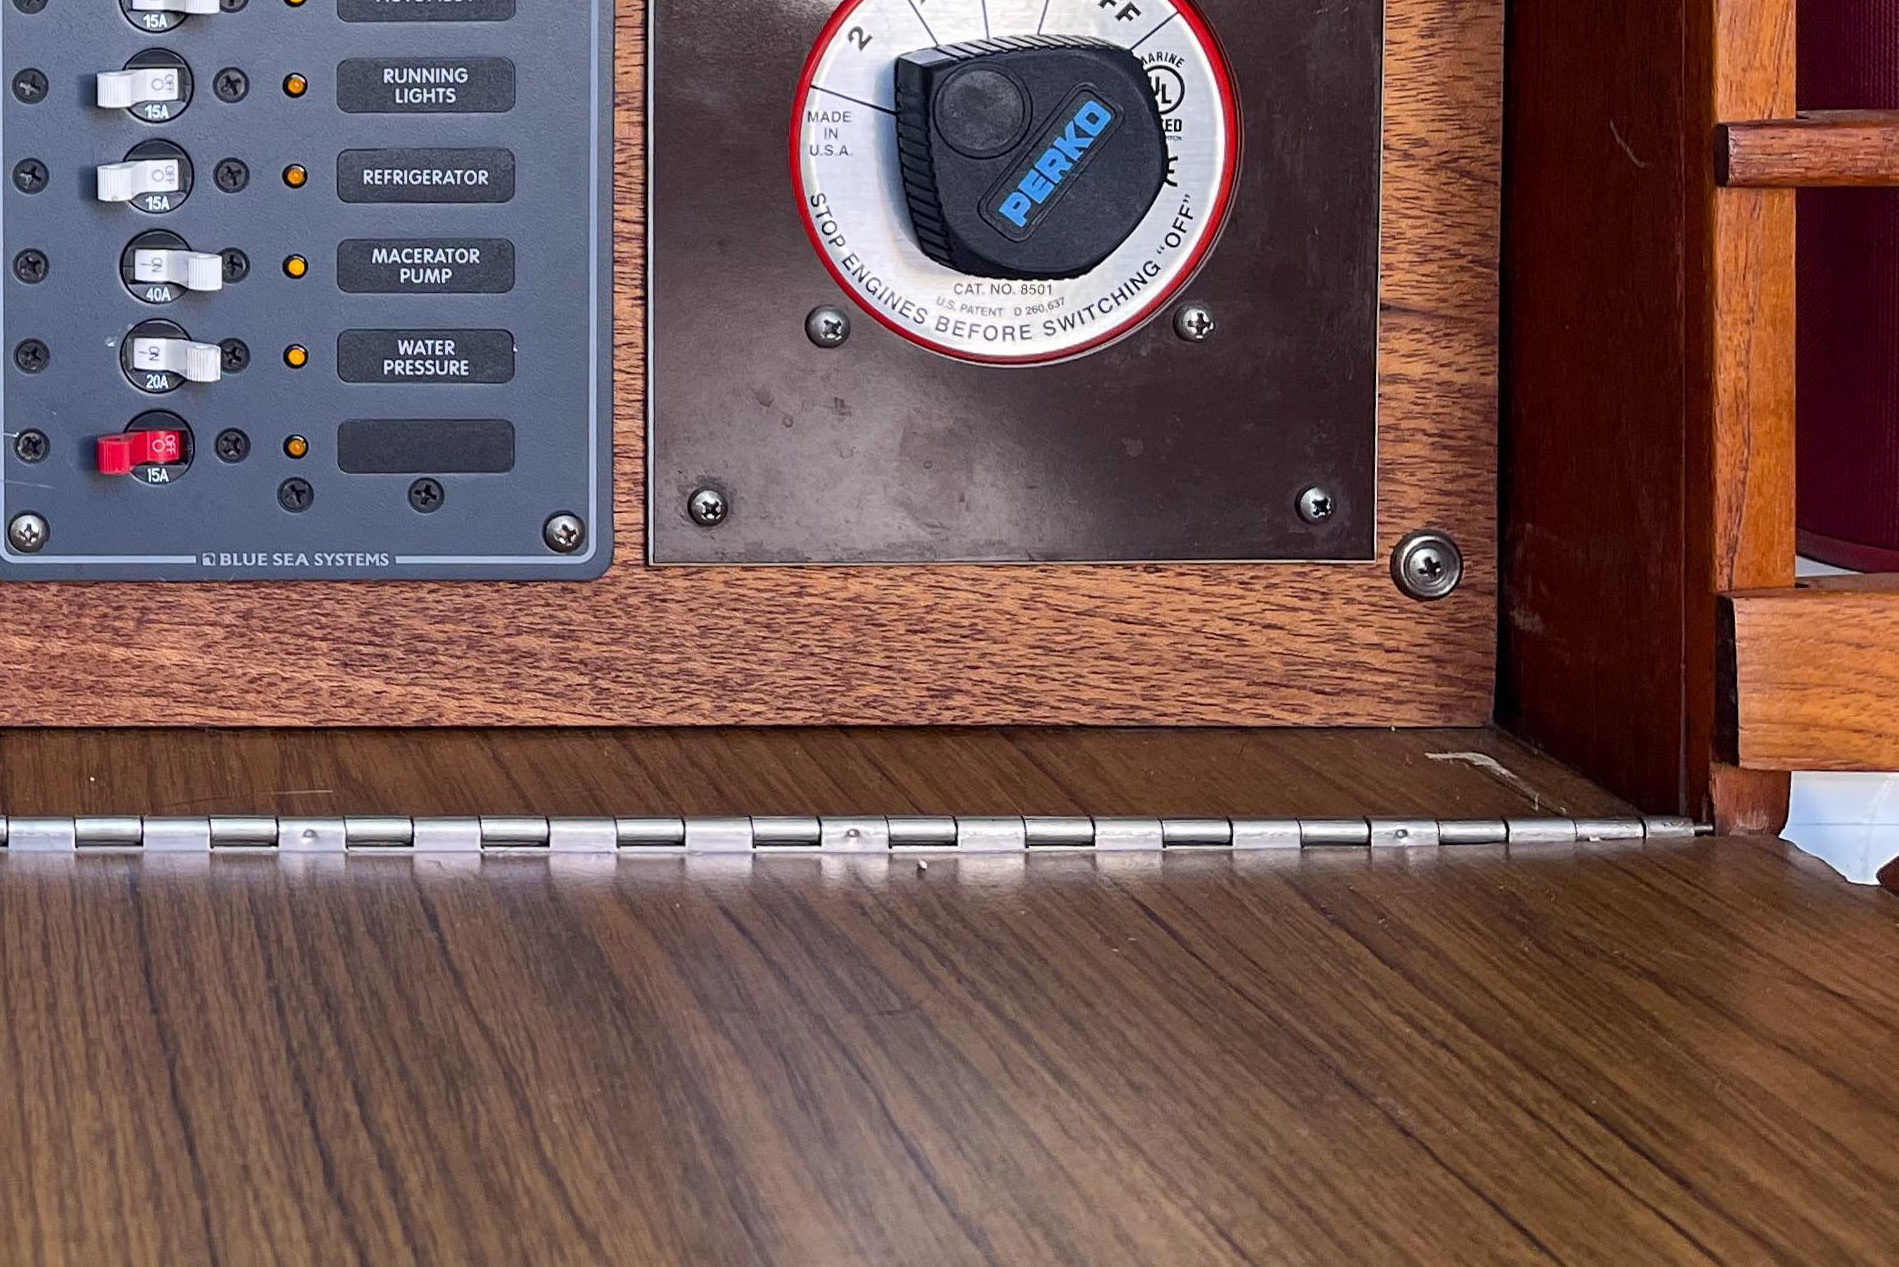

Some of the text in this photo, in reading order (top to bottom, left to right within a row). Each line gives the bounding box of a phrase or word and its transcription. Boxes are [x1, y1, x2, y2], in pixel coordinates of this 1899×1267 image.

[143, 14, 167, 28] 15A
[848, 25, 873, 51] 2
[383, 67, 468, 84] RUNNING
[395, 88, 457, 104] LIGHTS
[145, 104, 169, 119] 15A
[807, 111, 852, 123] MADE
[824, 128, 838, 139] IN
[809, 145, 853, 157] U.S.A.
[998, 100, 1112, 227] PERKO
[164, 165, 175, 184] OFF
[363, 169, 489, 185] REFRIGERATOR
[146, 196, 170, 210] 15A
[372, 248, 480, 264] MACERATOR
[151, 257, 163, 273] ON
[810, 193, 846, 249] STOP
[841, 253, 928, 325] ENGINES
[935, 315, 1032, 342] BEFORE
[1043, 260, 1162, 337] SWITCHING
[400, 268, 452, 284] PUMP
[146, 287, 171, 302] 40A
[953, 283, 1052, 295] CAT. NO. 8501
[936, 296, 957, 311] U.S.
[960, 303, 1004, 317] PATENT
[148, 346, 160, 361] ON
[397, 339, 456, 356] WATER
[383, 359, 469, 376] PRESSURE
[146, 374, 169, 389] 20A
[164, 434, 176, 454] OFF
[147, 468, 169, 482] 15A
[220, 552, 390, 566] BLUE SEA SYSTEMS
